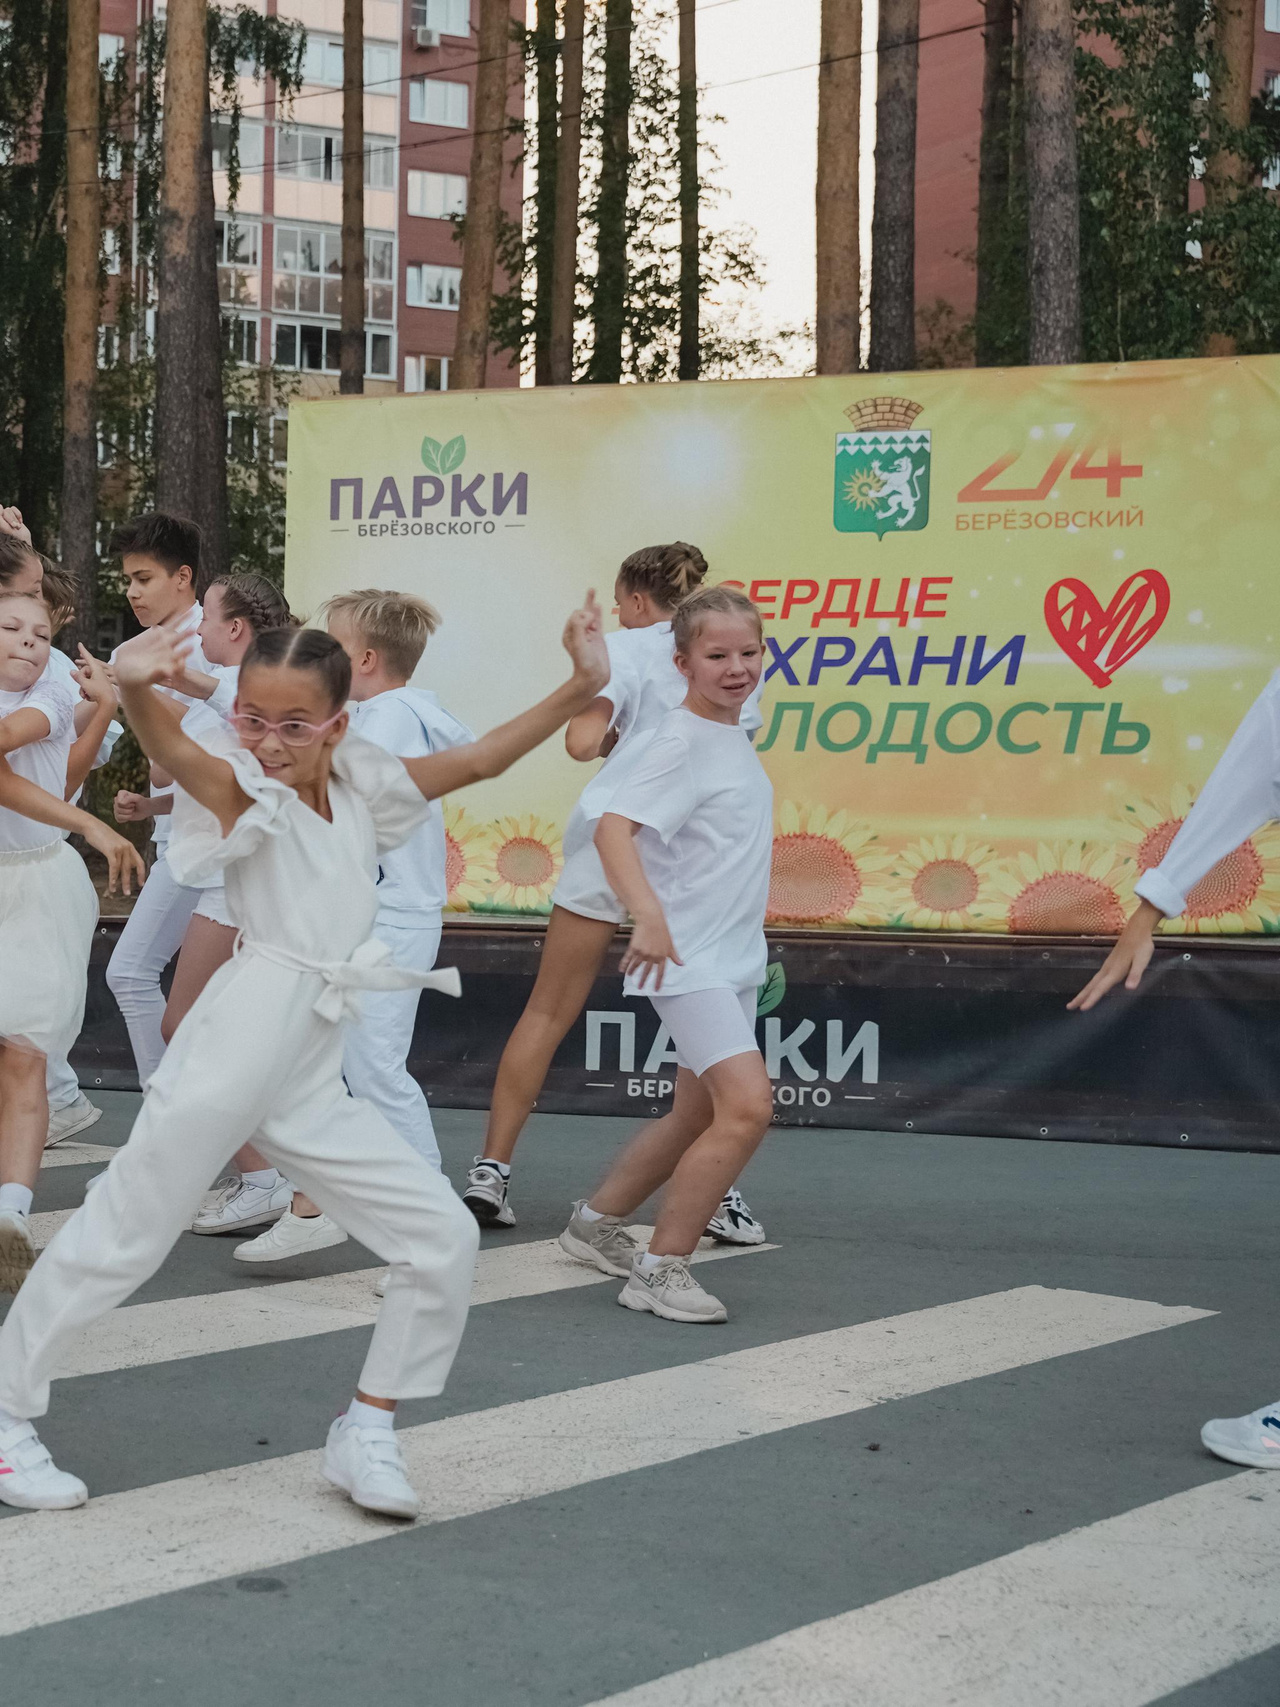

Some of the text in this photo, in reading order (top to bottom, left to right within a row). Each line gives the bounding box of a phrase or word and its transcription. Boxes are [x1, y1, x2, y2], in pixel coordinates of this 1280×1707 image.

[329, 471, 529, 521] ПАРКИ
[954, 505, 1144, 531] БЕРЁЗОВСКИЙ
[357, 520, 496, 537] БЕРЁЗОВСКОГО
[719, 576, 954, 628] ЕРДЦЕ
[755, 701, 1152, 765] ЛОДОСТЬ
[584, 1010, 880, 1085] ПАКИ
